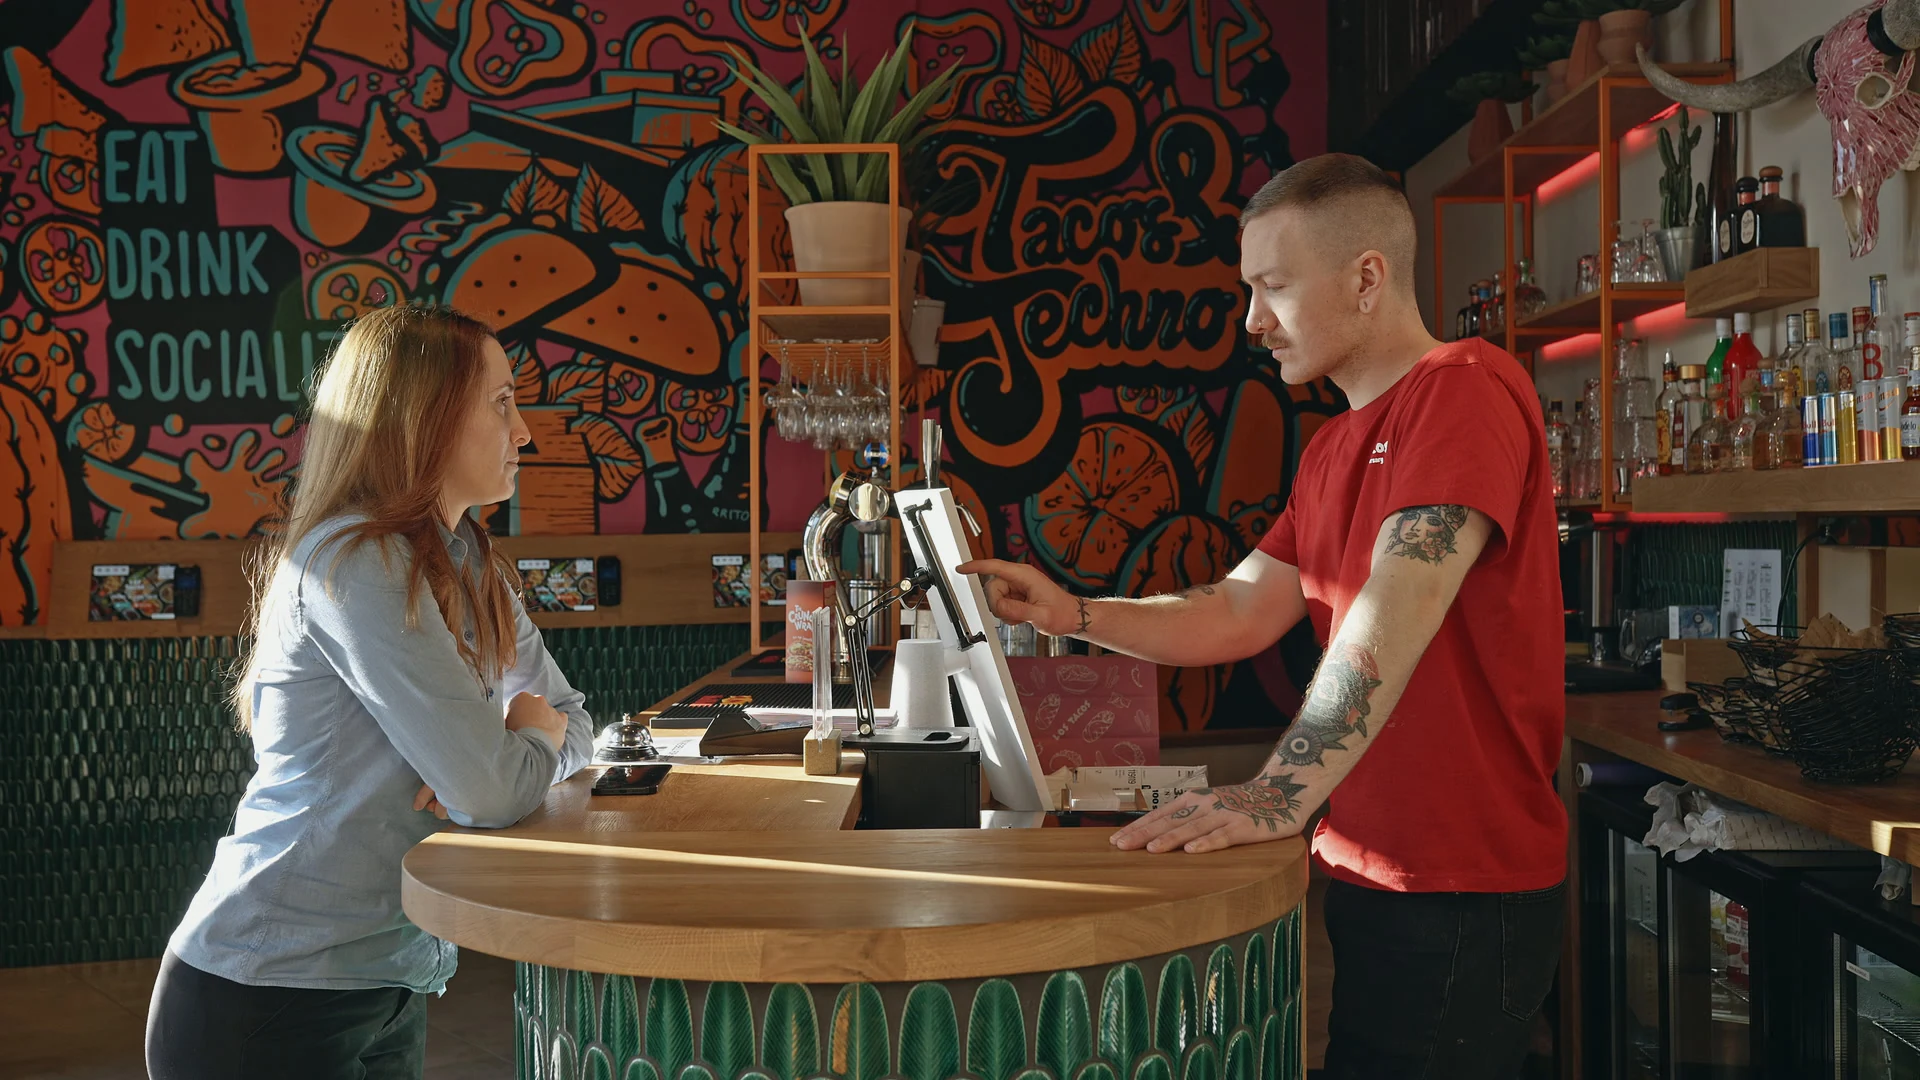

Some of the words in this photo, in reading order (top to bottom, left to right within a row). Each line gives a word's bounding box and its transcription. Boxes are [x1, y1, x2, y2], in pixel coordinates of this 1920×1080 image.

[104, 130, 198, 204] EAT
[910, 98, 1182, 276] Tacos
[106, 228, 269, 300] DRINK
[115, 328, 345, 403] SOCIALI
[920, 252, 1238, 447] Techno
[1900, 421, 1917, 431] odelo
[788, 609, 814, 624] CRUN
[794, 620, 813, 632] WRA
[1052, 723, 1070, 741] LOS
[1067, 700, 1092, 724] TACOS
